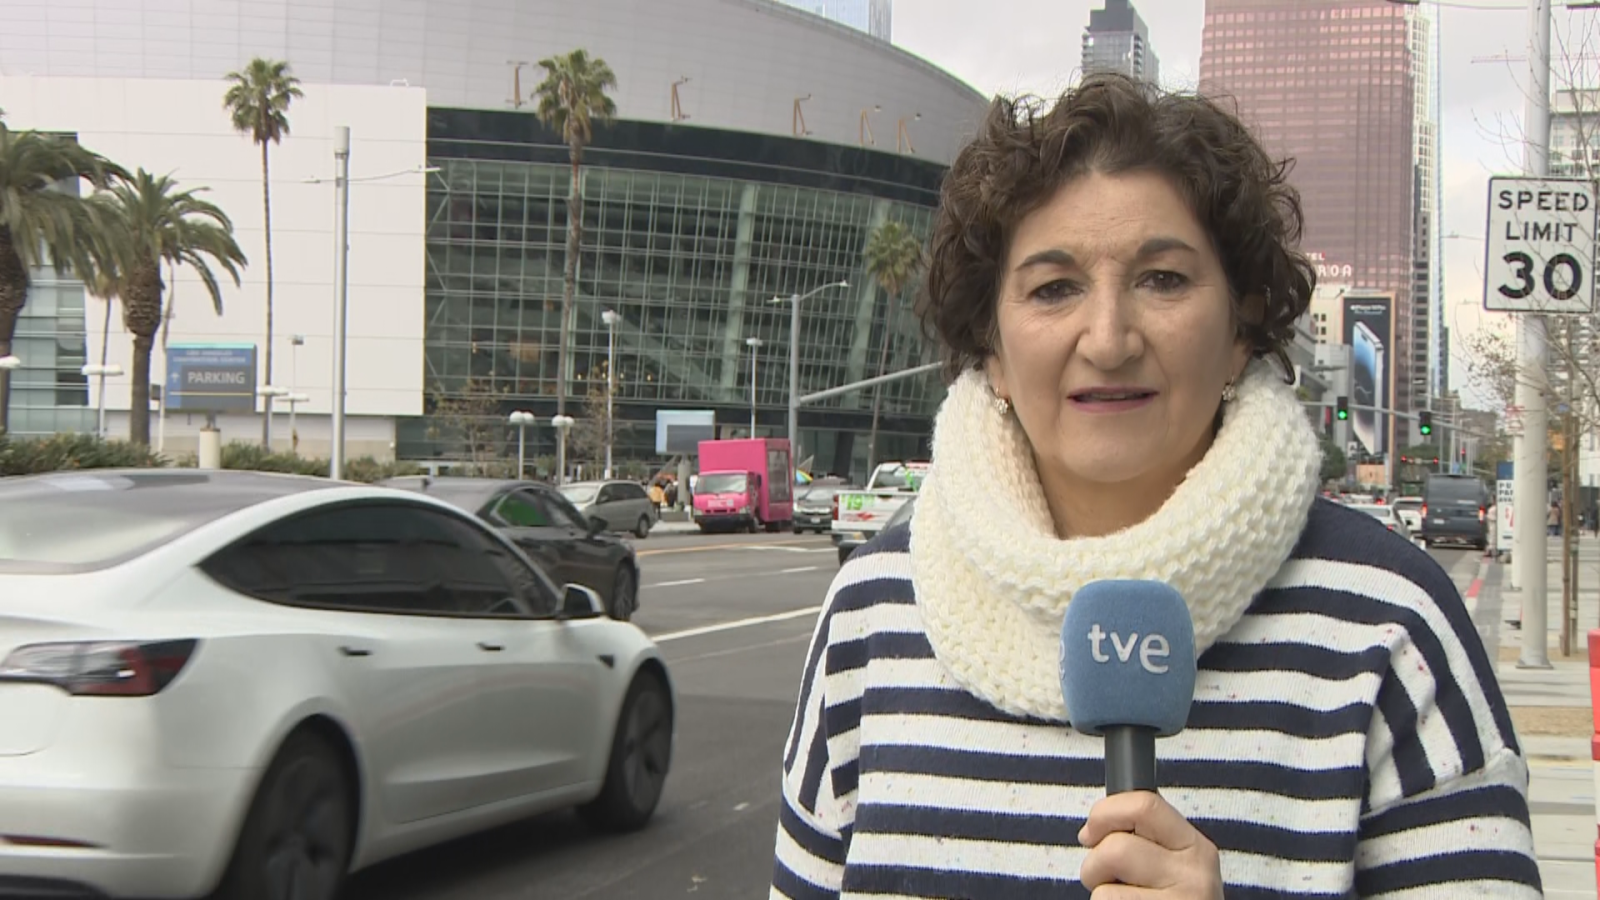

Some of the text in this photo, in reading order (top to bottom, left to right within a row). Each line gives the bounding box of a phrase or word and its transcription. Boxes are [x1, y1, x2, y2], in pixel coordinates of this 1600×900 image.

[1497, 189, 1589, 212] SPEED
[1505, 221, 1578, 242] LIMIT
[1317, 264, 1352, 277] ROA
[1497, 251, 1583, 300] 30
[187, 371, 245, 383] PARKING
[1087, 623, 1170, 674] tve
